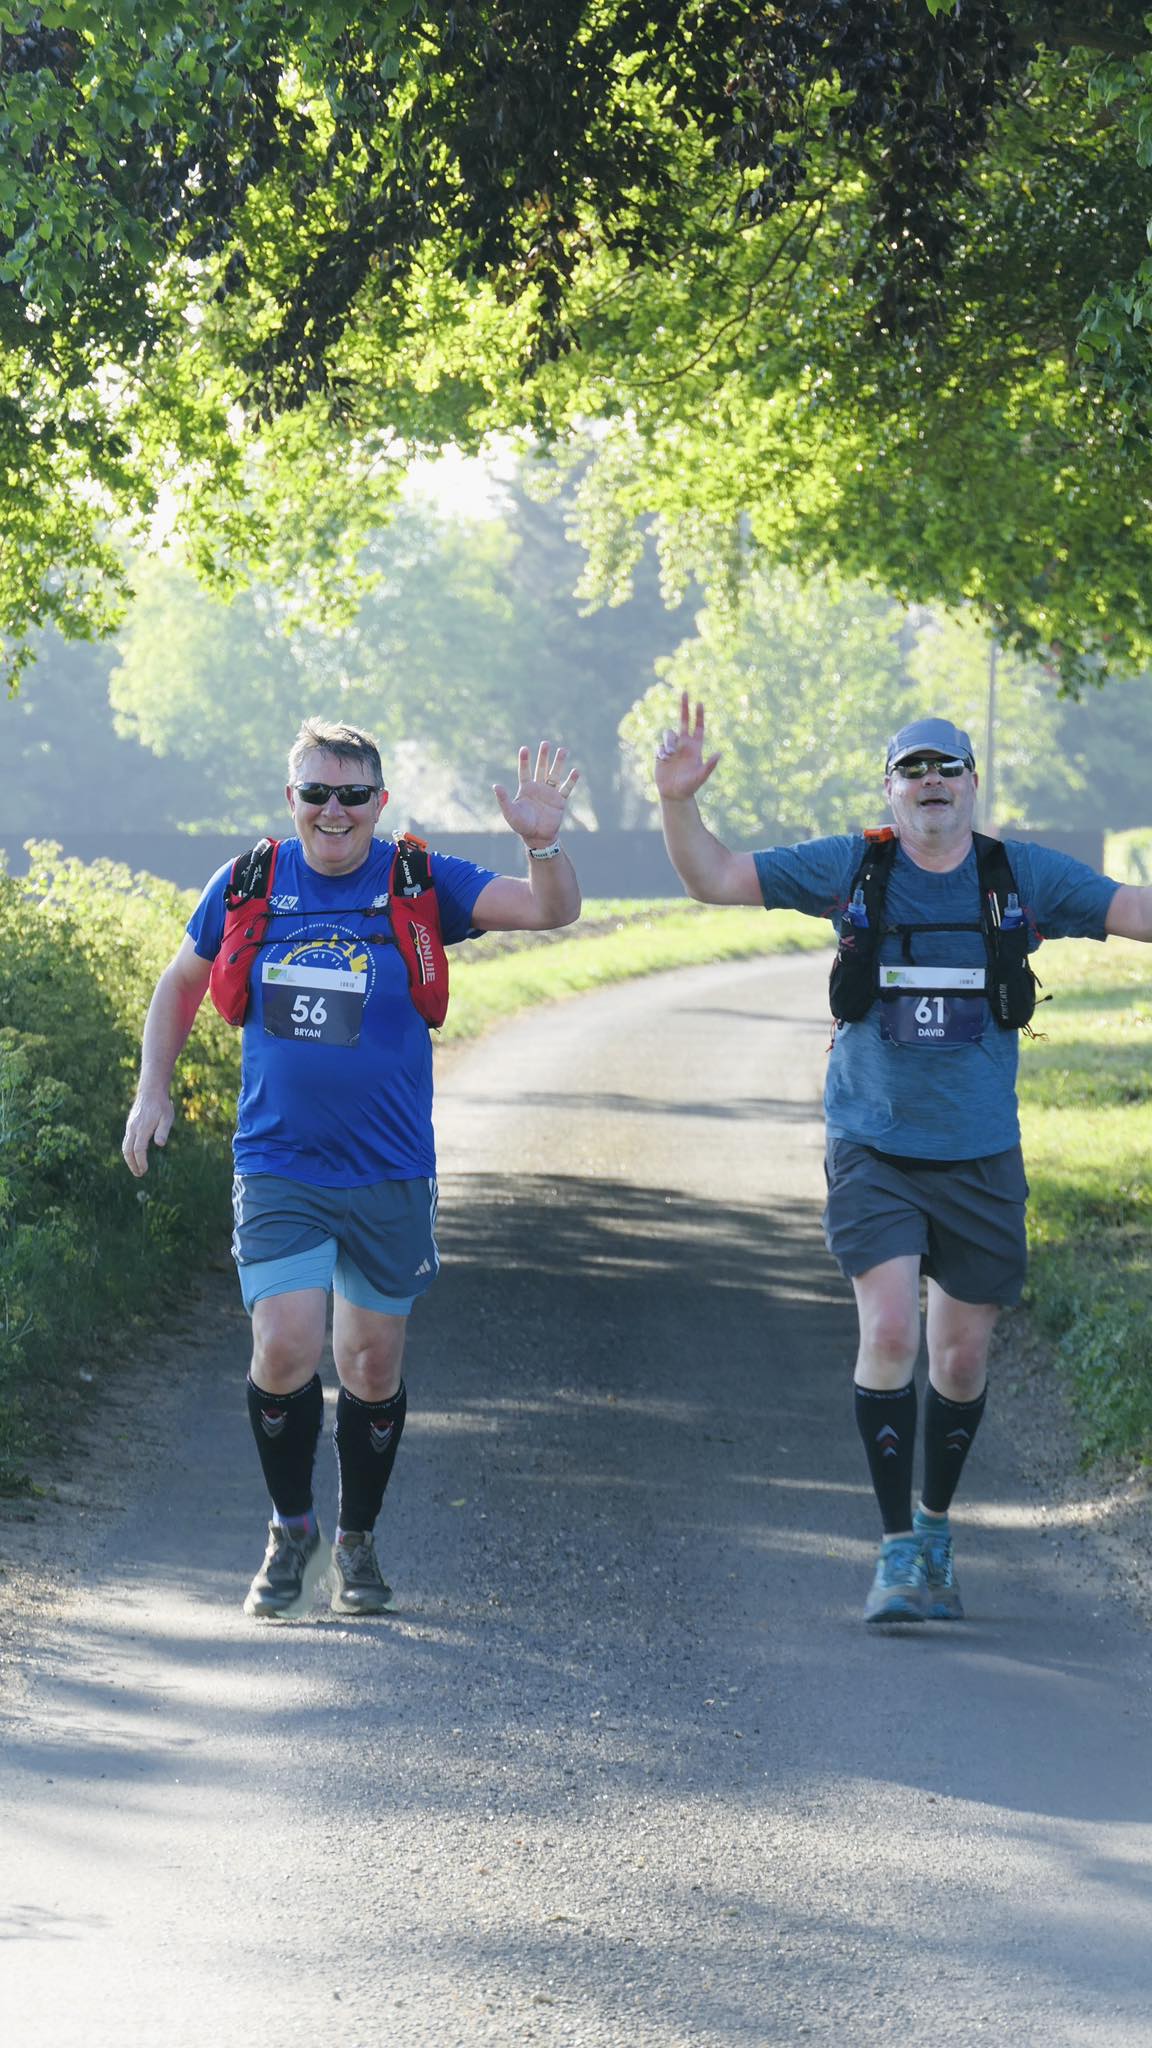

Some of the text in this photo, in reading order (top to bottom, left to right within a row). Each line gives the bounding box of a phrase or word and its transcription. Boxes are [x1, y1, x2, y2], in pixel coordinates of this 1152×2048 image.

[416, 923, 436, 982] AONIJIE
[291, 994, 328, 1025] 56
[914, 996, 944, 1024] 61
[294, 1027, 322, 1039] BRYAN
[918, 1028, 945, 1038] DAVID
